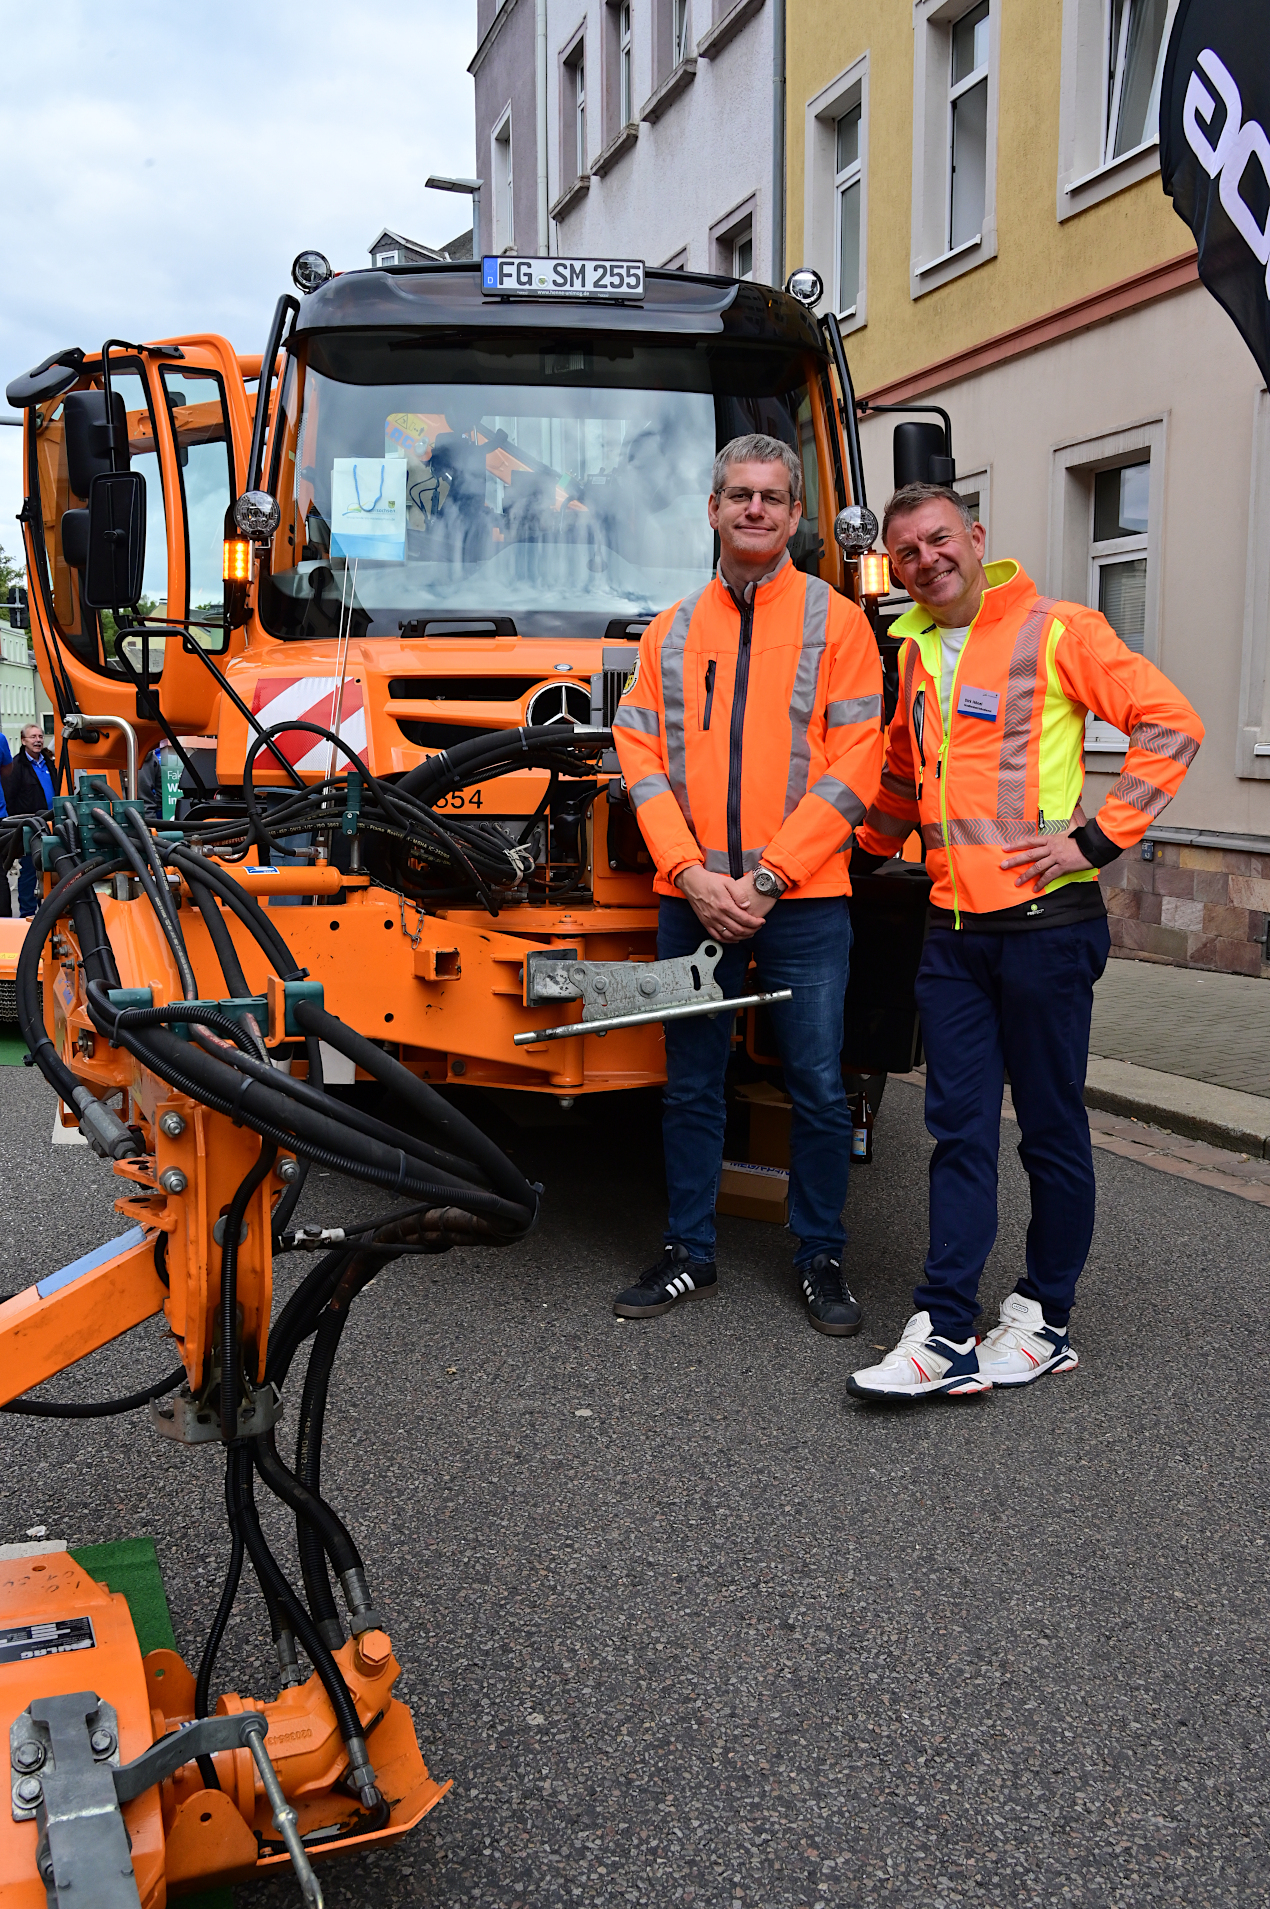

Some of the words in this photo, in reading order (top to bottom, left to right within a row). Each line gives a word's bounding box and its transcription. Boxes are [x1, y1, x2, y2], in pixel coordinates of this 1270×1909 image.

[487, 276, 494, 284] D
[498, 261, 533, 286] FG
[552, 262, 586, 288] SM
[593, 264, 641, 290] 255
